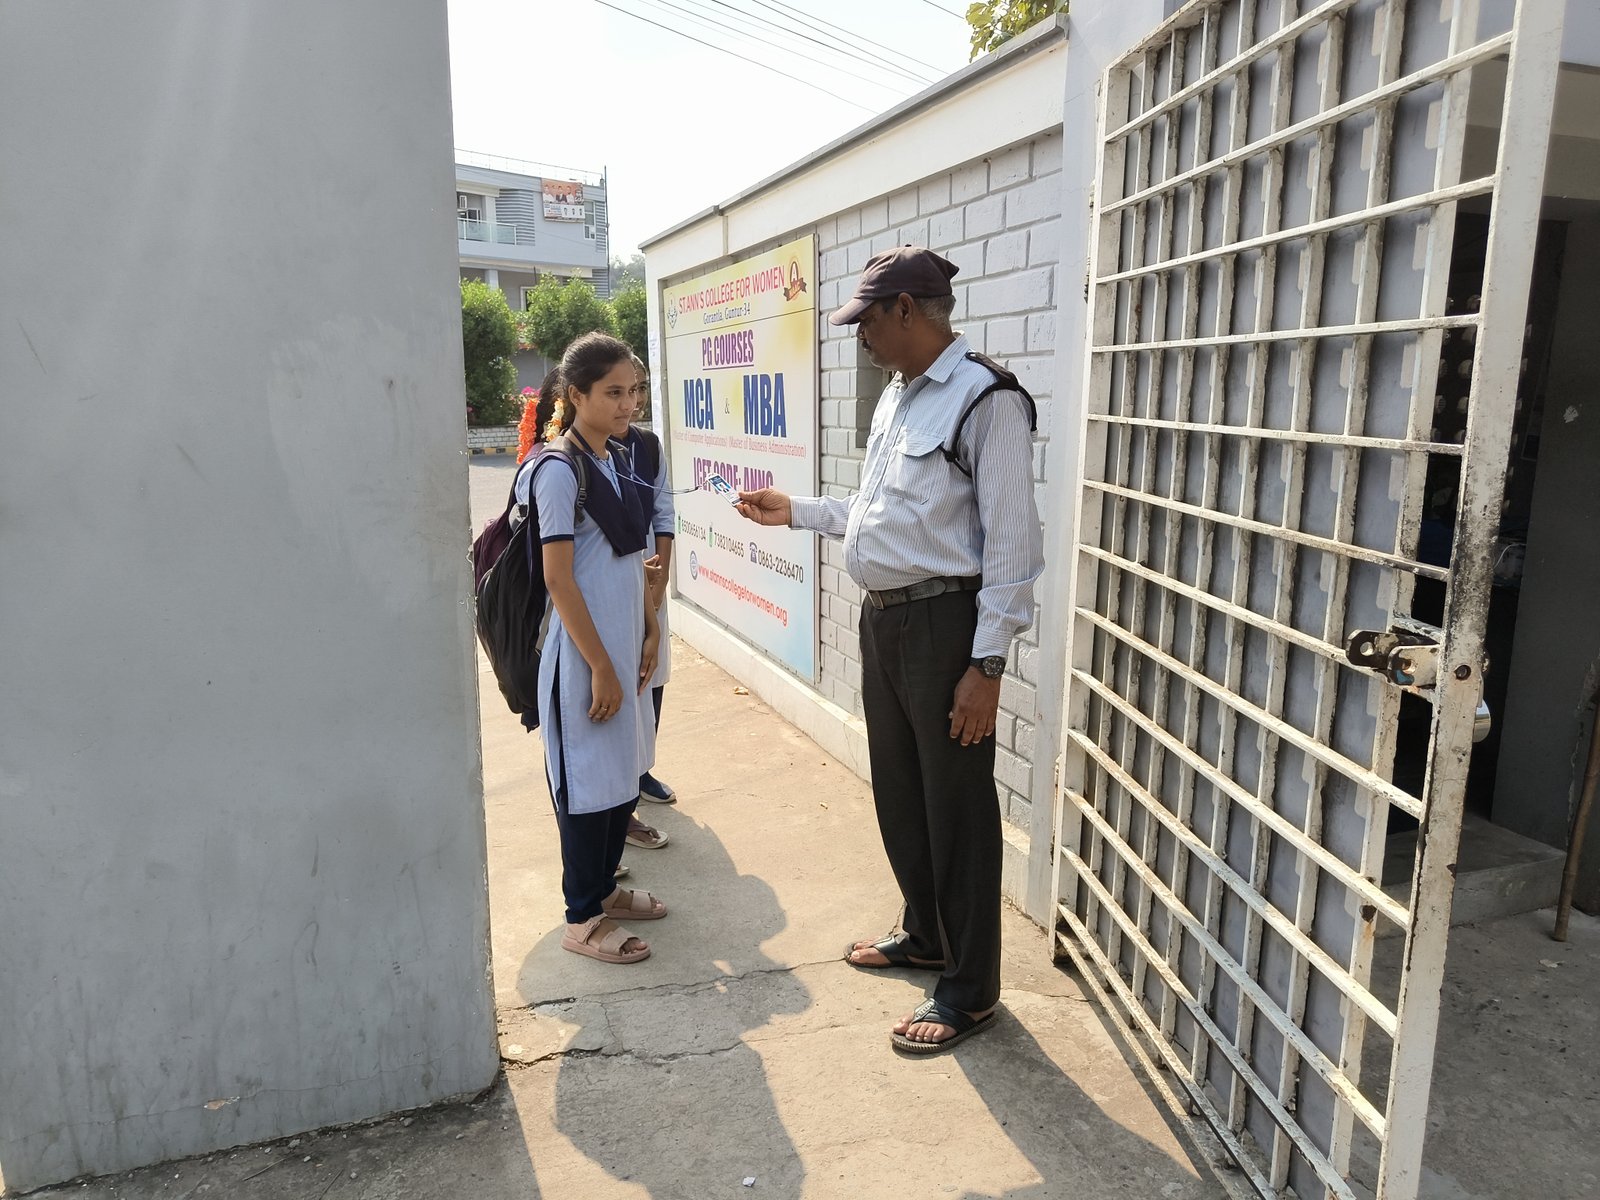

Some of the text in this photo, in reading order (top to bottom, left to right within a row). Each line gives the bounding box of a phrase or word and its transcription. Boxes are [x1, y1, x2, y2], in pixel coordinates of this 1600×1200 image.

[705, 281, 734, 308] COLLEGE
[735, 277, 750, 300] FOR
[752, 265, 785, 295] WOMEN
[702, 329, 754, 367] PG COURSES
[683, 378, 714, 430] MCA
[724, 397, 730, 414] &
[743, 373, 787, 438] MBA
[693, 457, 711, 492] ICET
[758, 549, 804, 584] 0863-2236470
